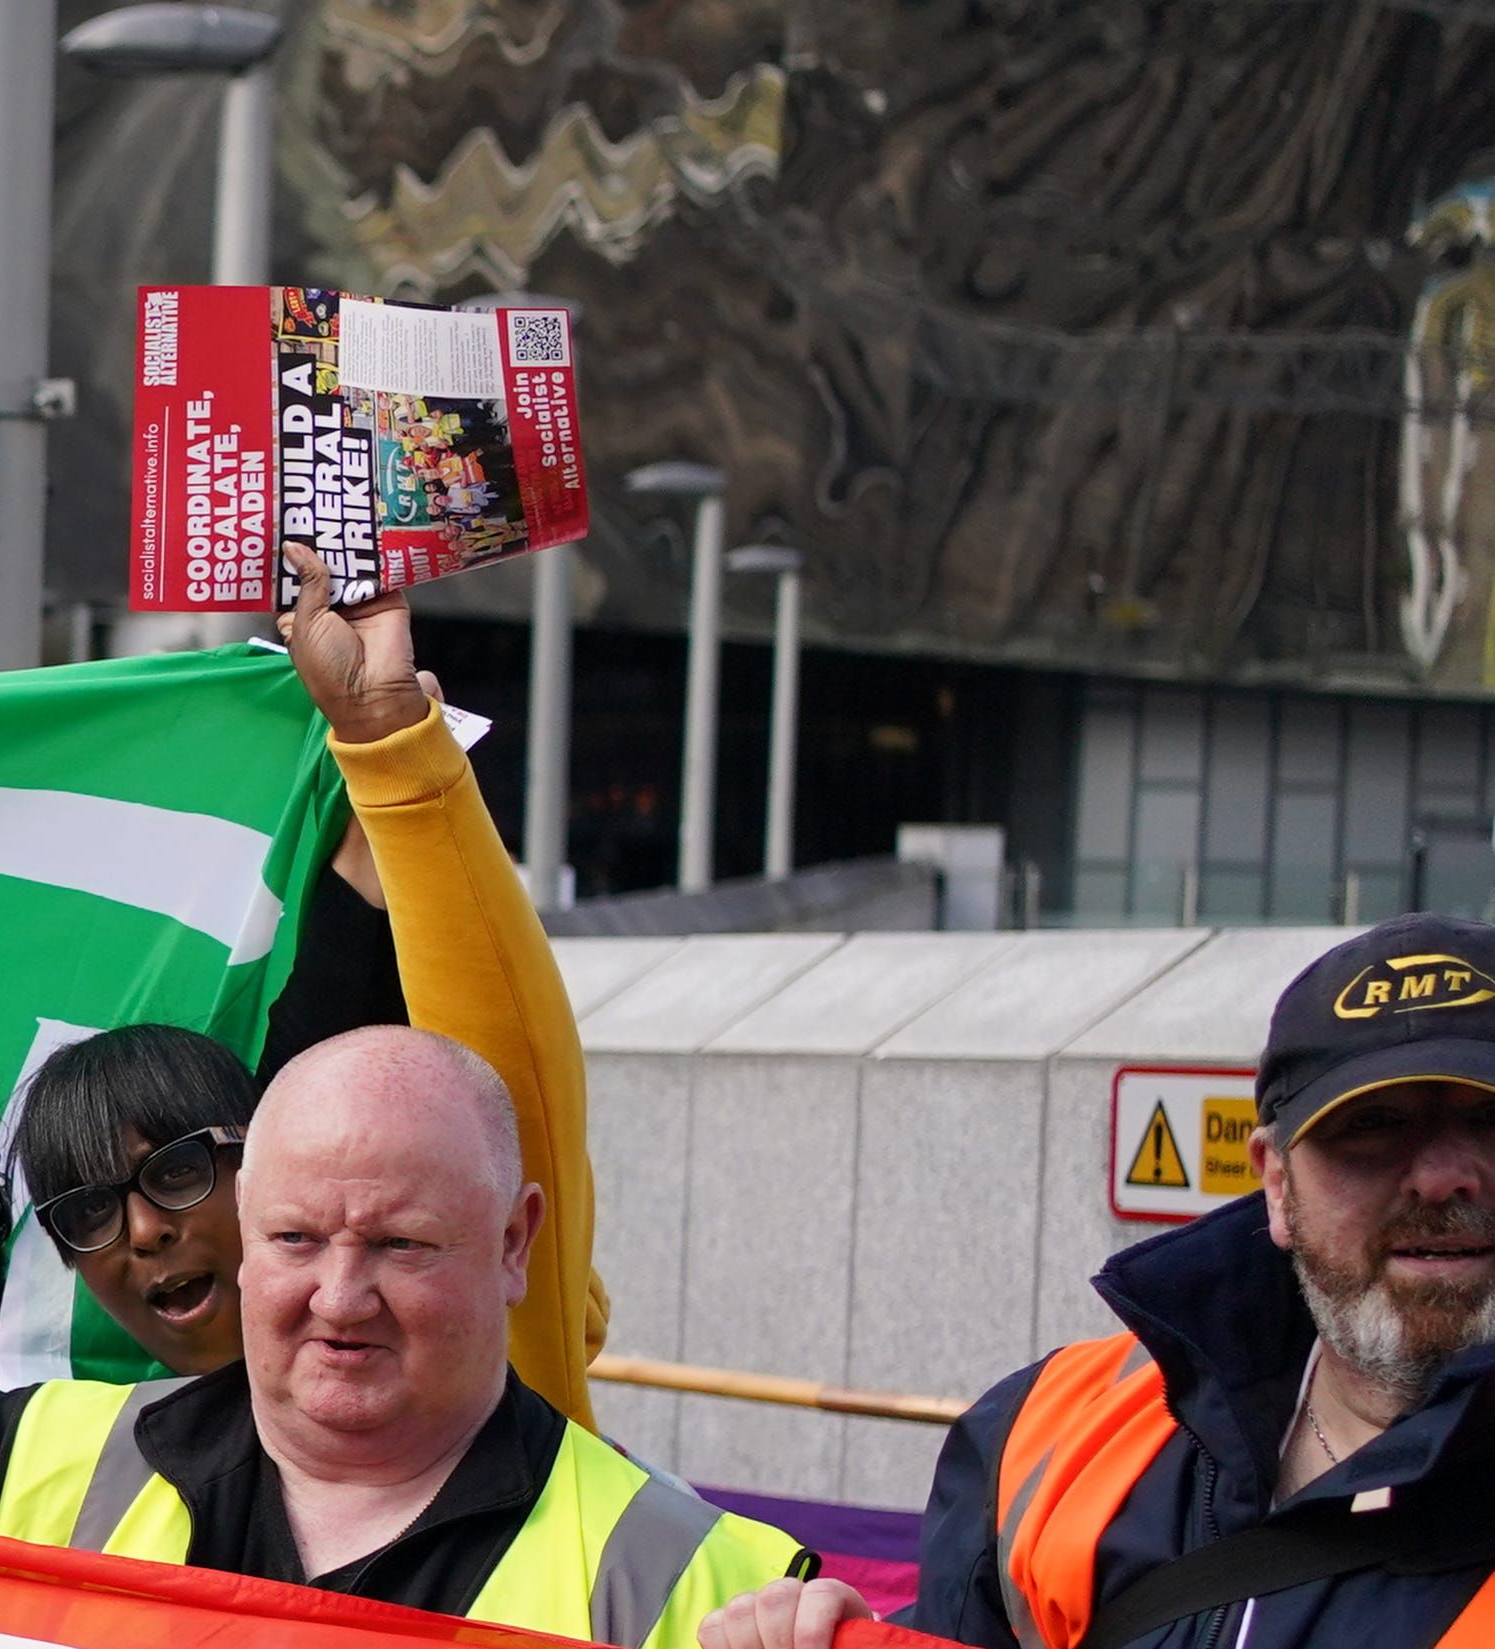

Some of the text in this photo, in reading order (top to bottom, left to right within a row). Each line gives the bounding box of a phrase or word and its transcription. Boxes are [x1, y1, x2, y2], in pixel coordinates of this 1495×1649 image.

[143, 293, 163, 387] SOCIALIST
[160, 291, 179, 386] ALTERNATIVE
[281, 362, 314, 397] A
[513, 372, 533, 419] Join
[532, 372, 557, 467] Socialist
[550, 371, 581, 489] Alternative
[139, 423, 160, 600] socialistalternative.info
[186, 390, 214, 602] COORDINATE,
[213, 424, 242, 602] ESCALATE,
[282, 404, 314, 536] BUILD
[240, 451, 266, 600] BROADEN
[342, 436, 377, 607] STRIKE!
[385, 548, 407, 592] TRIKE
[1362, 969, 1472, 1006] RMT
[1206, 1111, 1253, 1143] Dan
